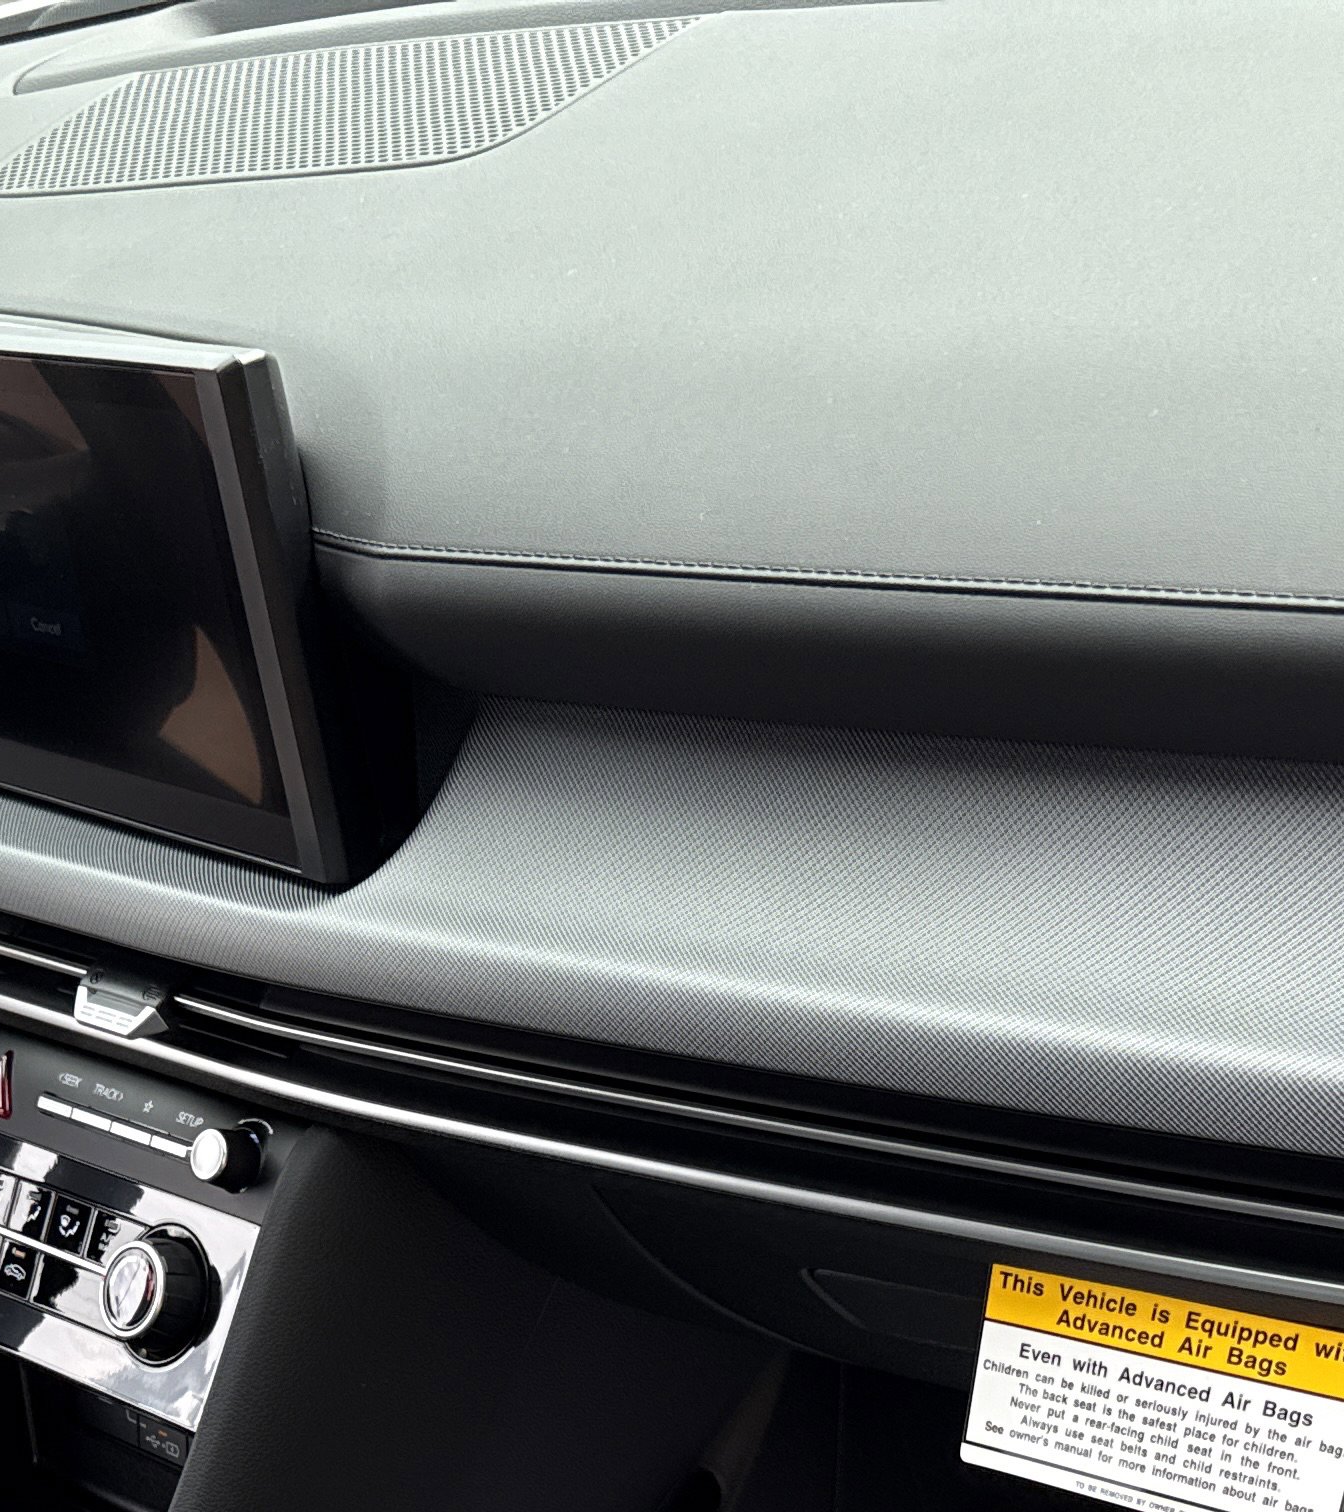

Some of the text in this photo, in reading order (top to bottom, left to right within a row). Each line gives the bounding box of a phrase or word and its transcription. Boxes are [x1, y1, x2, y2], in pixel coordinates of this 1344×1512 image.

[175, 1111, 205, 1128] SETUP
[999, 1270, 1044, 1297] This
[1059, 1283, 1137, 1317] Vehicle
[1151, 1303, 1171, 1324] is
[1185, 1310, 1299, 1351] Equipped
[1056, 1309, 1287, 1377] Advanced Air Bags
[983, 1358, 1029, 1379] Children
[1034, 1373, 1055, 1386] can
[1060, 1377, 1075, 1391] be
[1080, 1382, 1111, 1400] killed
[1116, 1393, 1129, 1404] or
[1134, 1398, 1189, 1422] seriously
[1194, 1410, 1239, 1431] injured
[1244, 1422, 1261, 1439] by
[1267, 1428, 1288, 1443] the
[1294, 1436, 1312, 1449] air
[1018, 1382, 1297, 1463] The back seat is the safest place for children.
[1019, 1342, 1313, 1428] Even with Advanced Air Bags
[984, 1420, 1005, 1435] See
[1009, 1429, 1049, 1447] owner's
[1054, 1441, 1093, 1458] manual
[1097, 1450, 1113, 1464] for
[1118, 1458, 1146, 1474] more
[1151, 1466, 1216, 1492] information
[1222, 1485, 1257, 1503] about
[1262, 1496, 1279, 1508] air
[1009, 1396, 1302, 1481] Never put a rear-facing child seat in the front.
[1020, 1414, 1280, 1493] Always use seat belts and child restraints.
